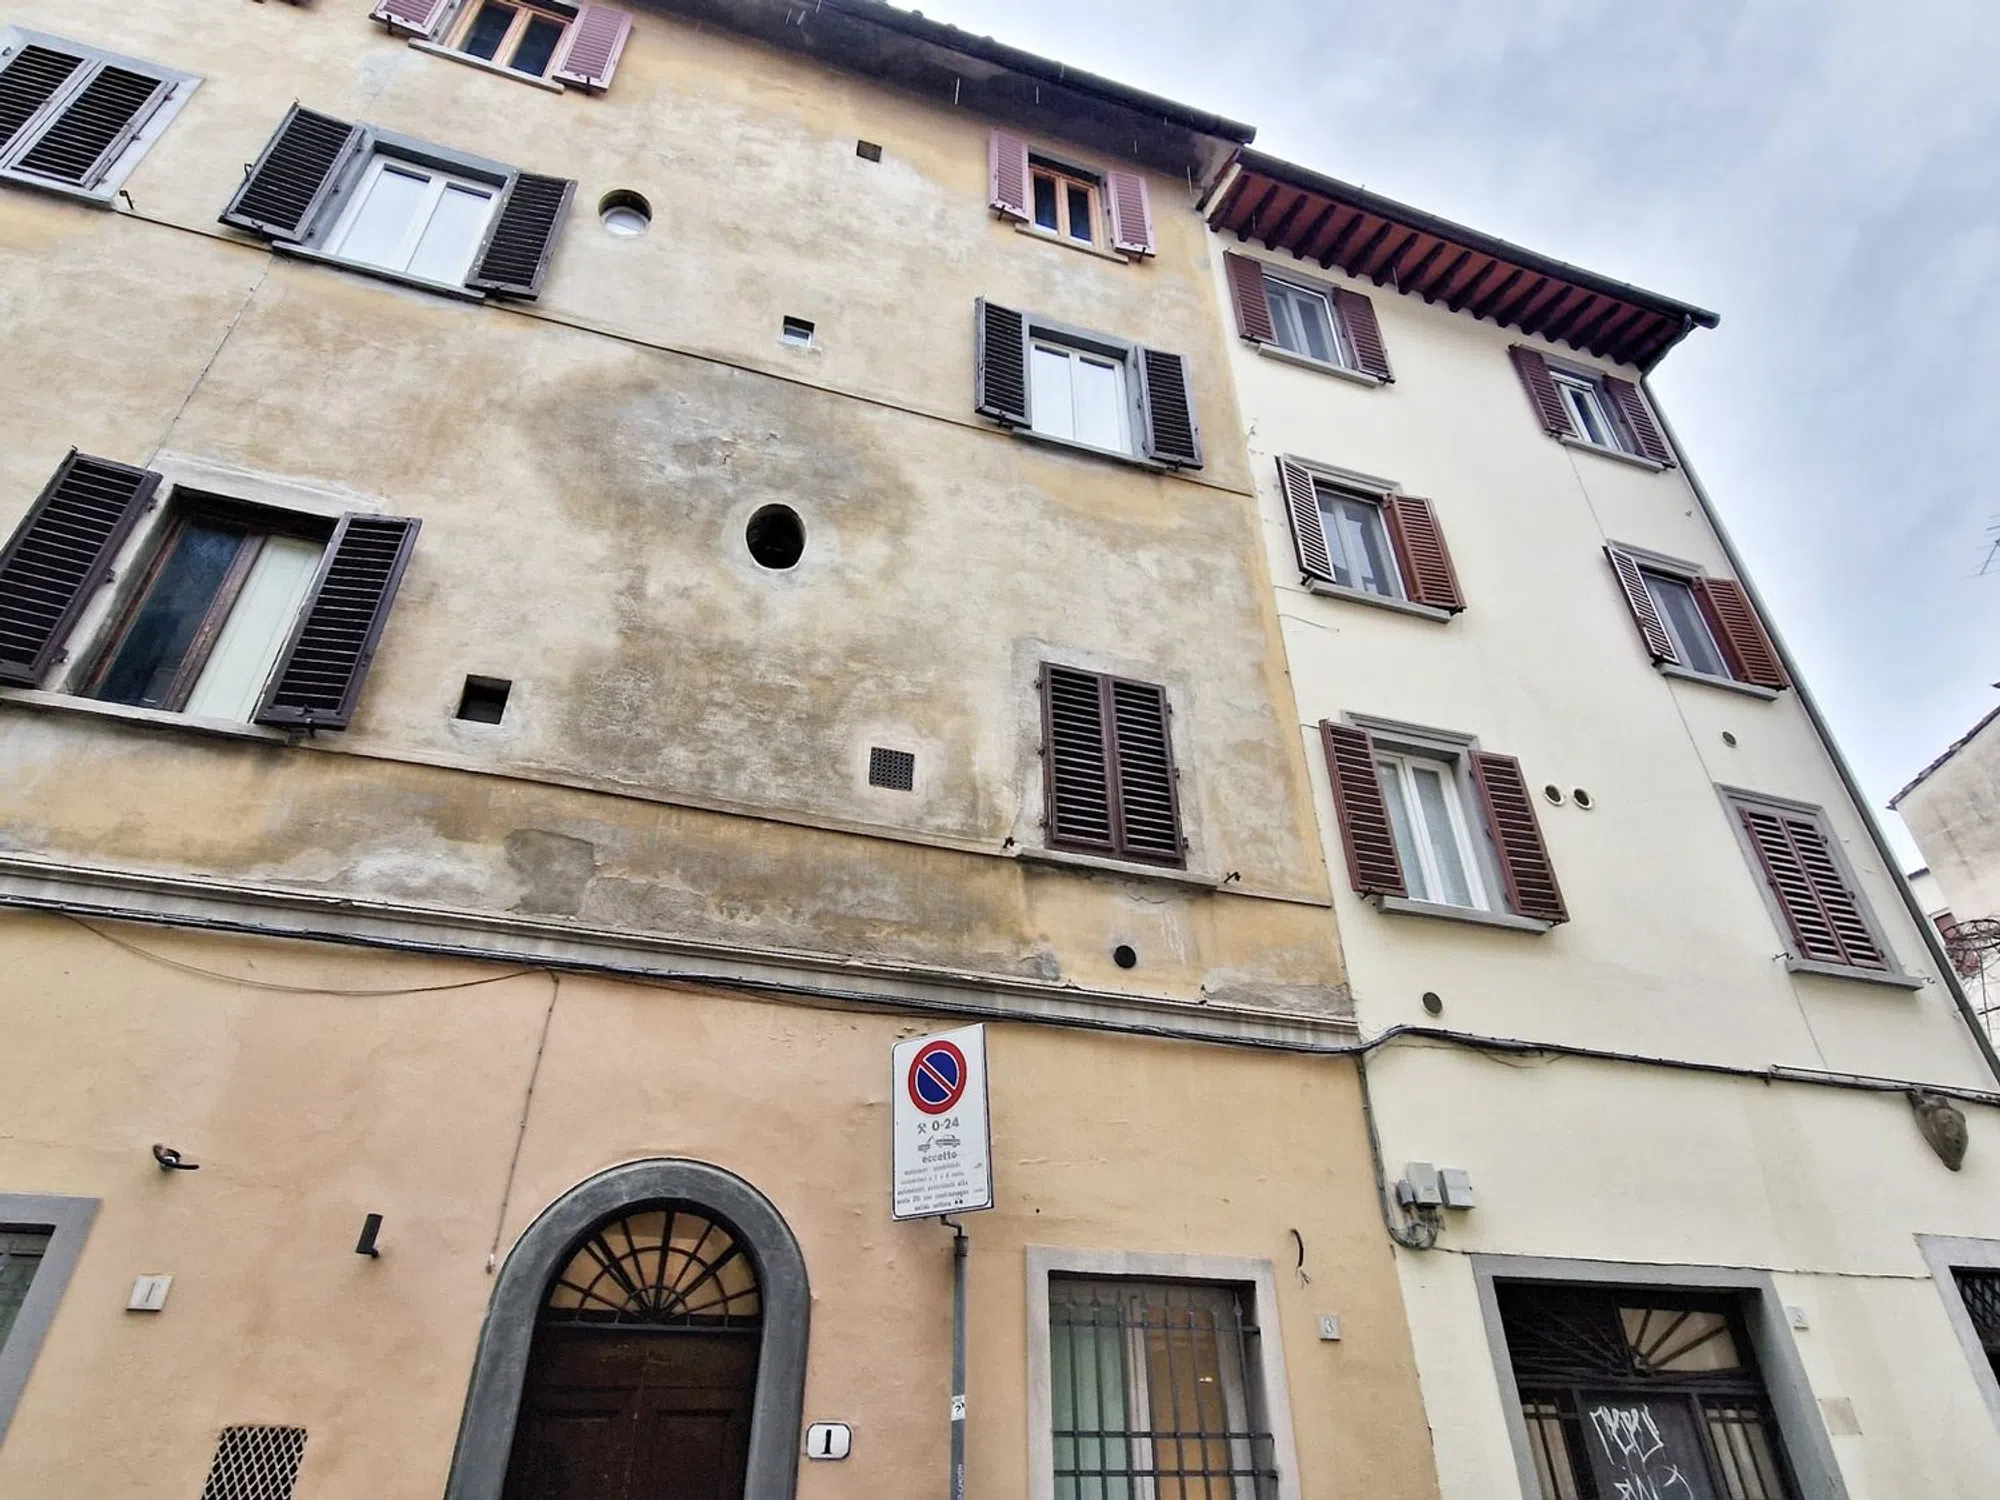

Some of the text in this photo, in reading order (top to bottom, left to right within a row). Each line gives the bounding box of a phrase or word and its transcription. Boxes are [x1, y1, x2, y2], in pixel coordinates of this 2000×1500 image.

[932, 1116, 959, 1131] 0-24
[922, 1150, 957, 1163] eccetto
[821, 1429, 832, 1455] 1
